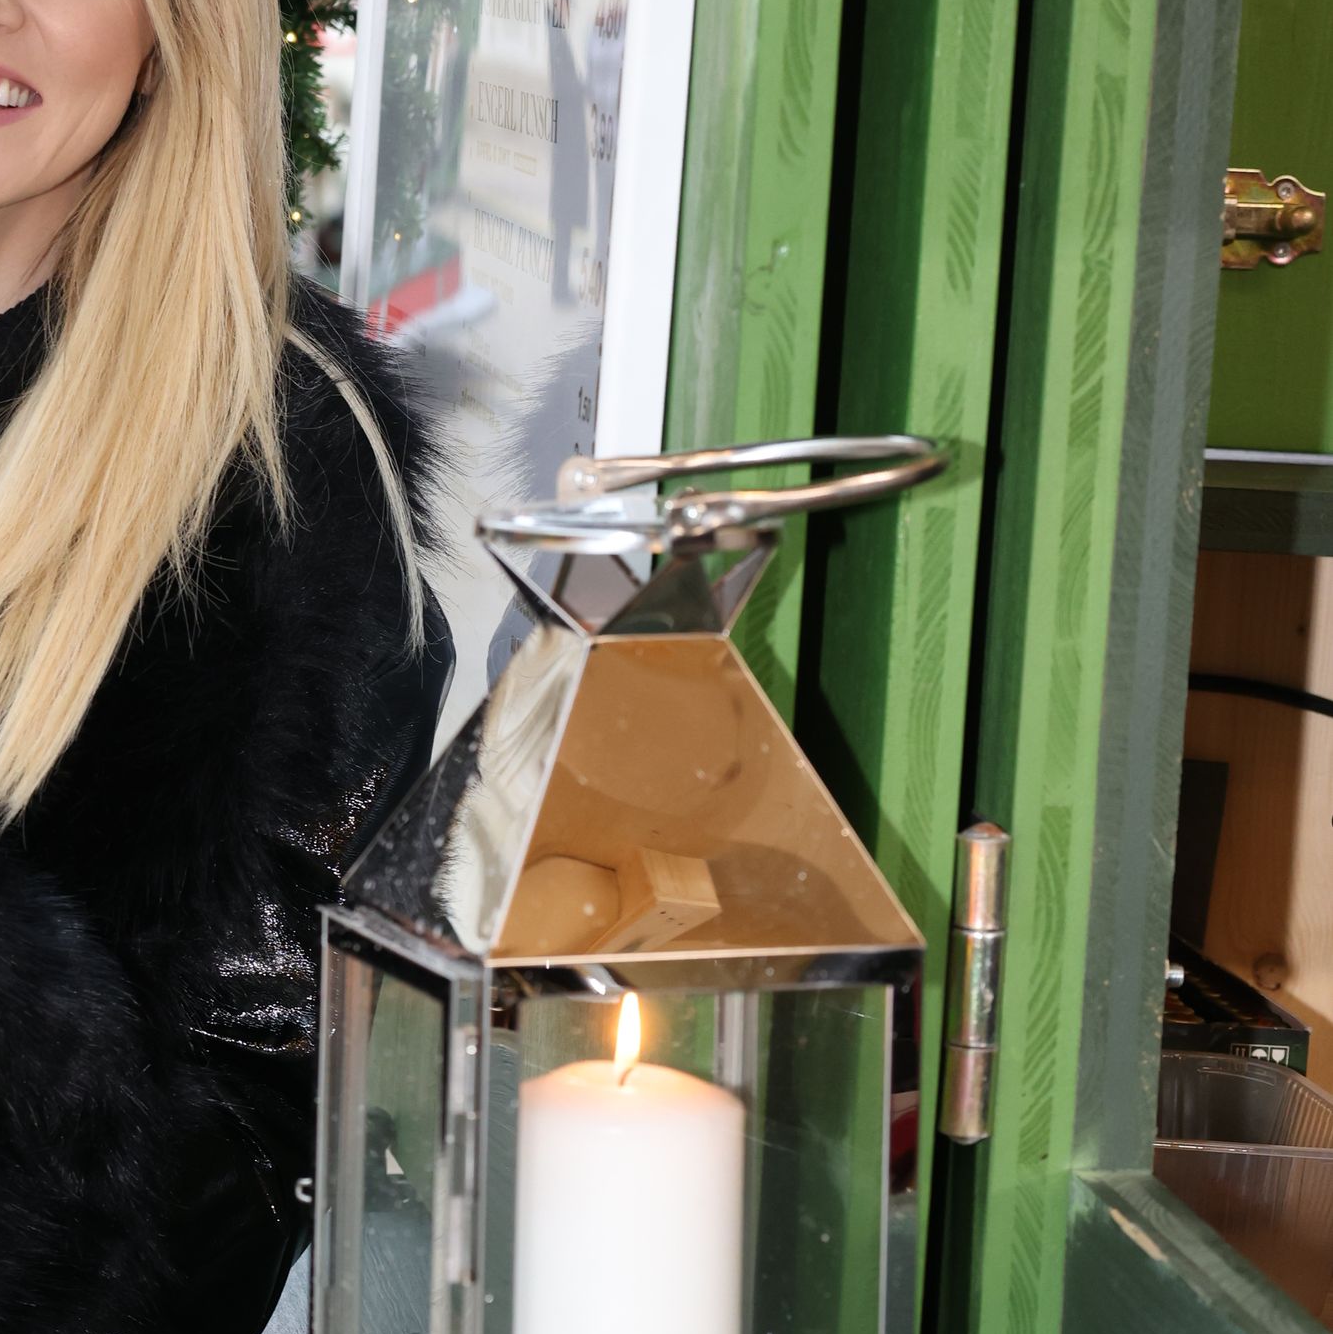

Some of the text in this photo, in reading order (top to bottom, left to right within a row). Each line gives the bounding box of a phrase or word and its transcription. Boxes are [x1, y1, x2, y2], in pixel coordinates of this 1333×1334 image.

[477, 80, 560, 144] ENGERL PUNSCH
[589, 102, 616, 163] 3,90
[516, 225, 555, 284] PUNSCH
